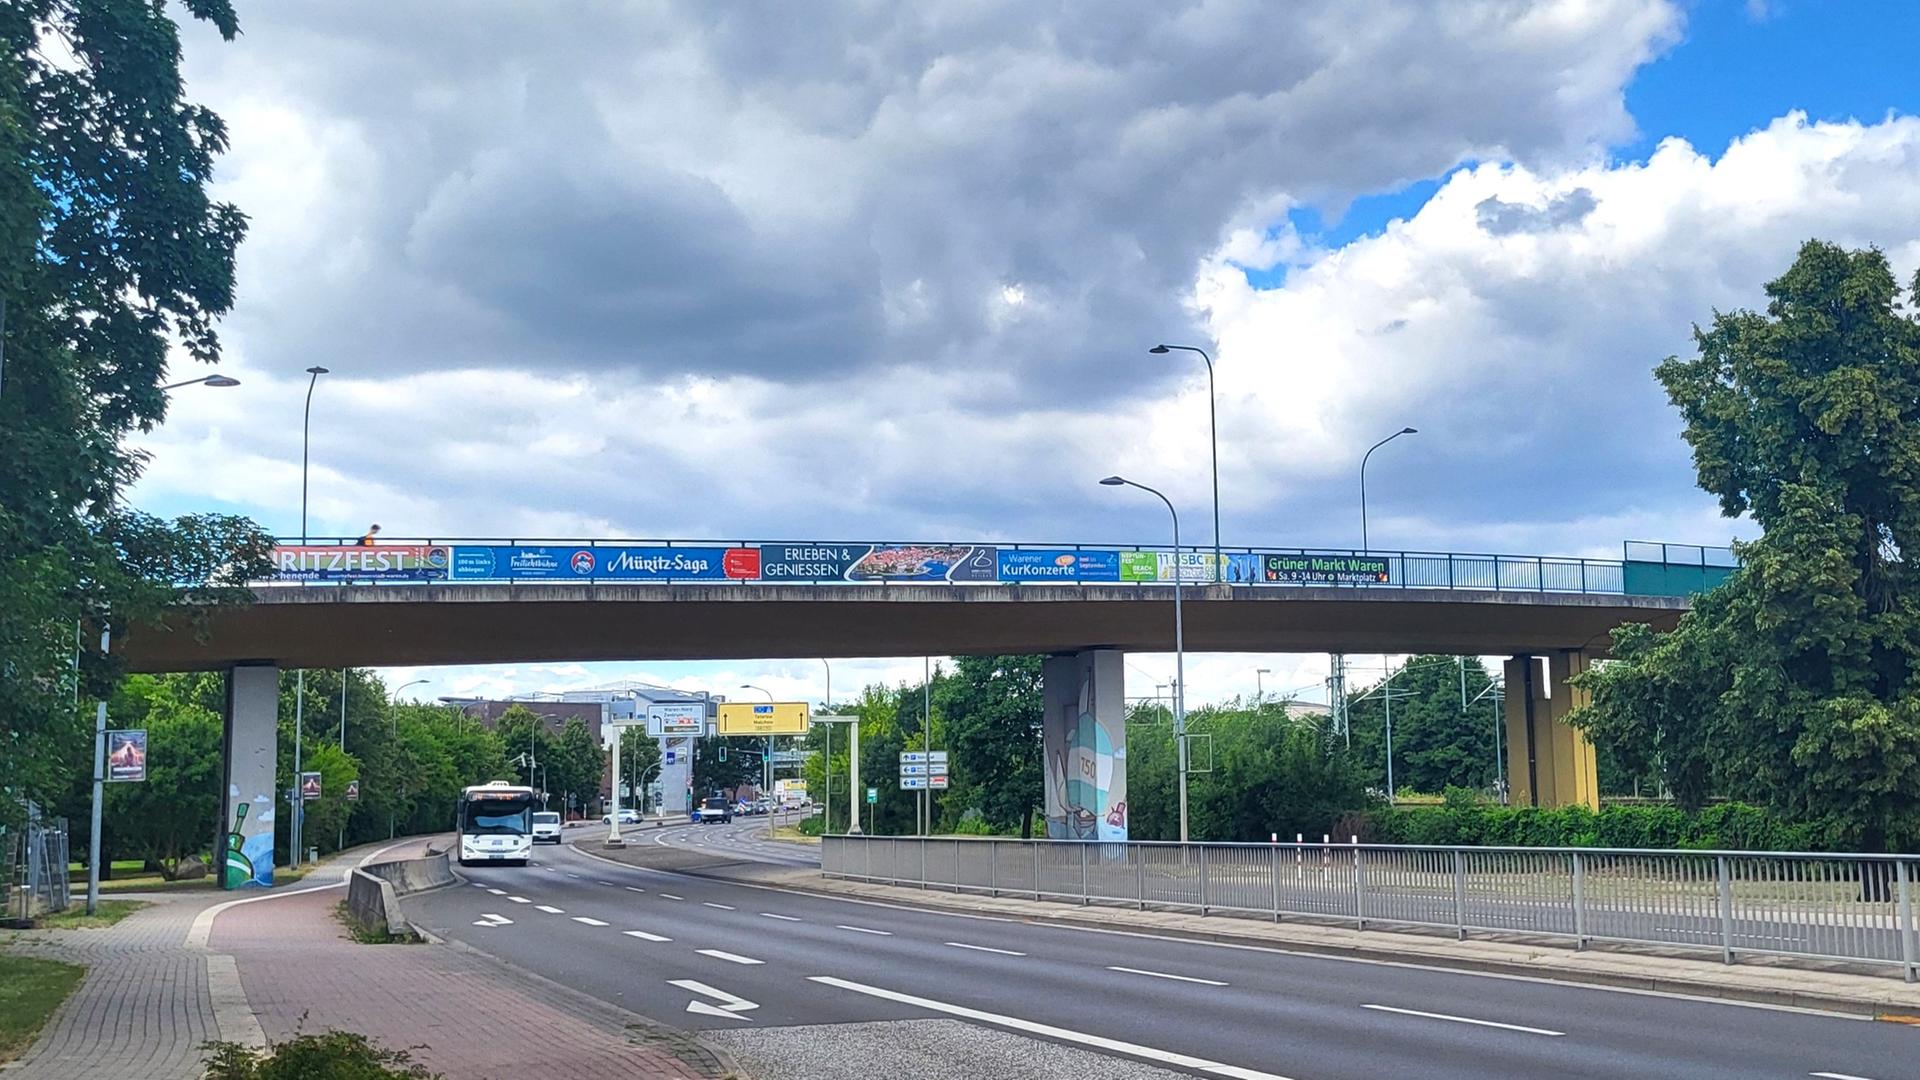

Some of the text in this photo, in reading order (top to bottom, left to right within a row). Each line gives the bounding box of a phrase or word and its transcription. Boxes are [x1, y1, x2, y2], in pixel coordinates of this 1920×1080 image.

[785, 549, 851, 560] ERLEBEN &
[1008, 554, 1042, 563] Warener
[607, 551, 708, 574] Müritz-Saga
[1269, 558, 1384, 572] Grüner Markt Waren
[765, 564, 839, 576] GENIESSEN
[1002, 564, 1075, 576] KurKonzerte
[1278, 572, 1289, 580] Sa.
[1291, 571, 1297, 580] 9
[1312, 572, 1326, 581] Uhr
[1337, 573, 1376, 583] Marktplatz
